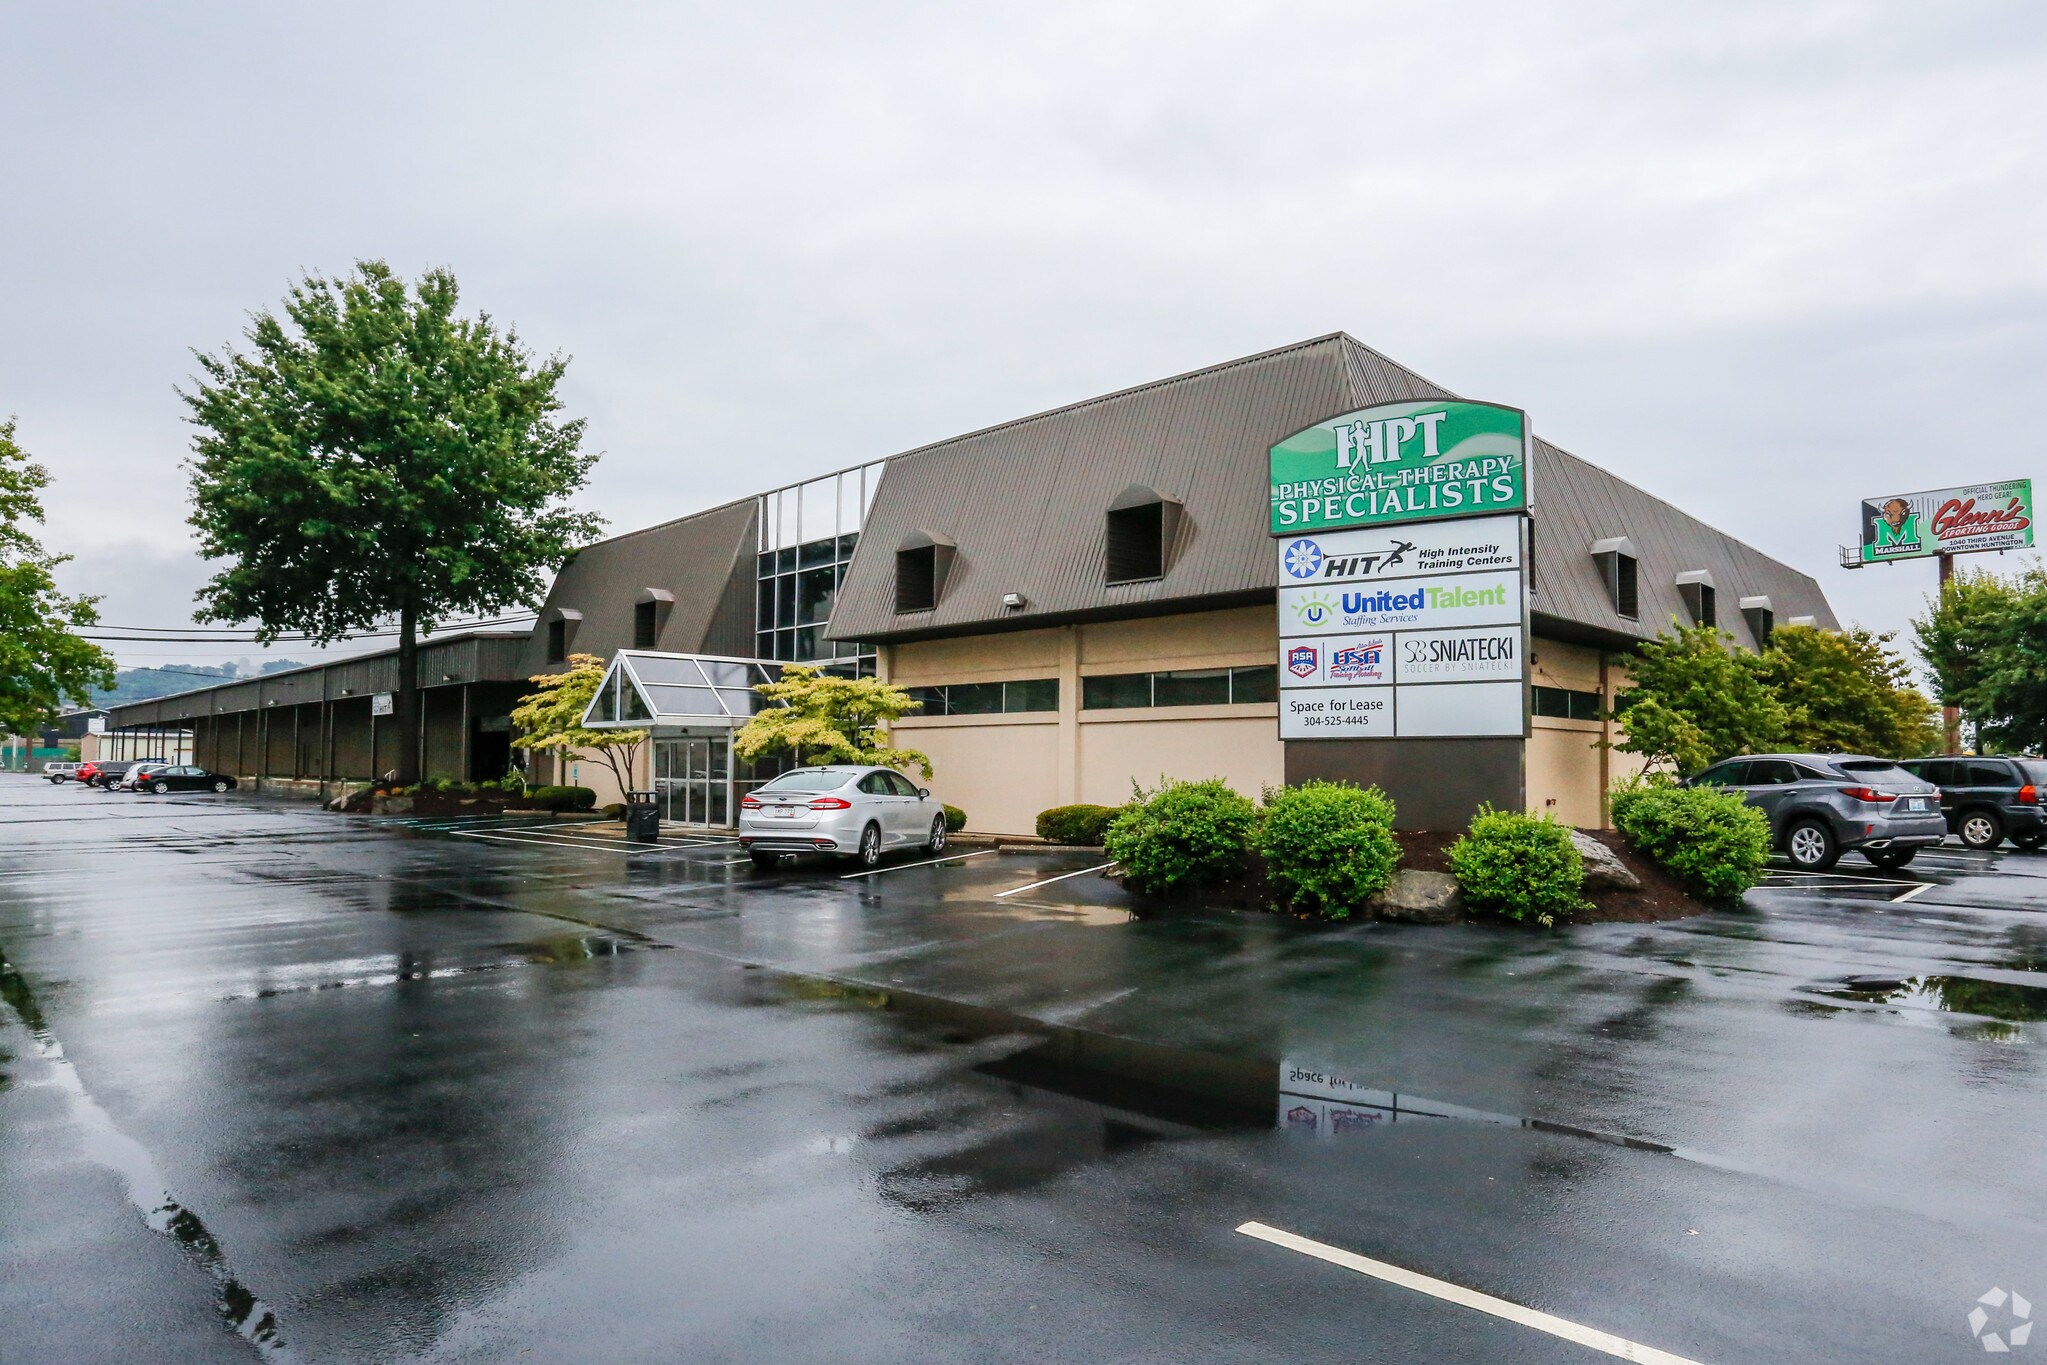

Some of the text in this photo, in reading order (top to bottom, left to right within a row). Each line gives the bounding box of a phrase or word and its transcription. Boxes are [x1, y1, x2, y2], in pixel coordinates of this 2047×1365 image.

[1279, 455, 1513, 500] PHYSICAL THERAPY
[1963, 481, 2027, 496] OFFICIAL THUNDERING
[1977, 491, 2012, 501] HERD GEAR!
[1278, 475, 1515, 526] SPECIALISTS
[1931, 497, 2026, 536] Glenn's
[1943, 522, 2019, 539] SPORTING GOODS
[1989, 534, 2015, 542] AVENUE
[1419, 544, 1500, 559] High Intensity
[1875, 545, 1920, 555] MARSHALL
[1942, 539, 2024, 552] DOWNTOWN HUNTINGTON
[1324, 555, 1381, 578] HIT
[1417, 554, 1513, 571] Training Centers
[1342, 612, 1418, 627] Staffing Services
[1292, 652, 1314, 662] ASA
[1429, 637, 1513, 662] SNIATECKI
[1333, 650, 1380, 665] USA
[1404, 660, 1513, 674] SOCCER BY SNIATECKI
[1290, 698, 1384, 714] Space for Lease
[1304, 715, 1369, 726] 304-525-4445
